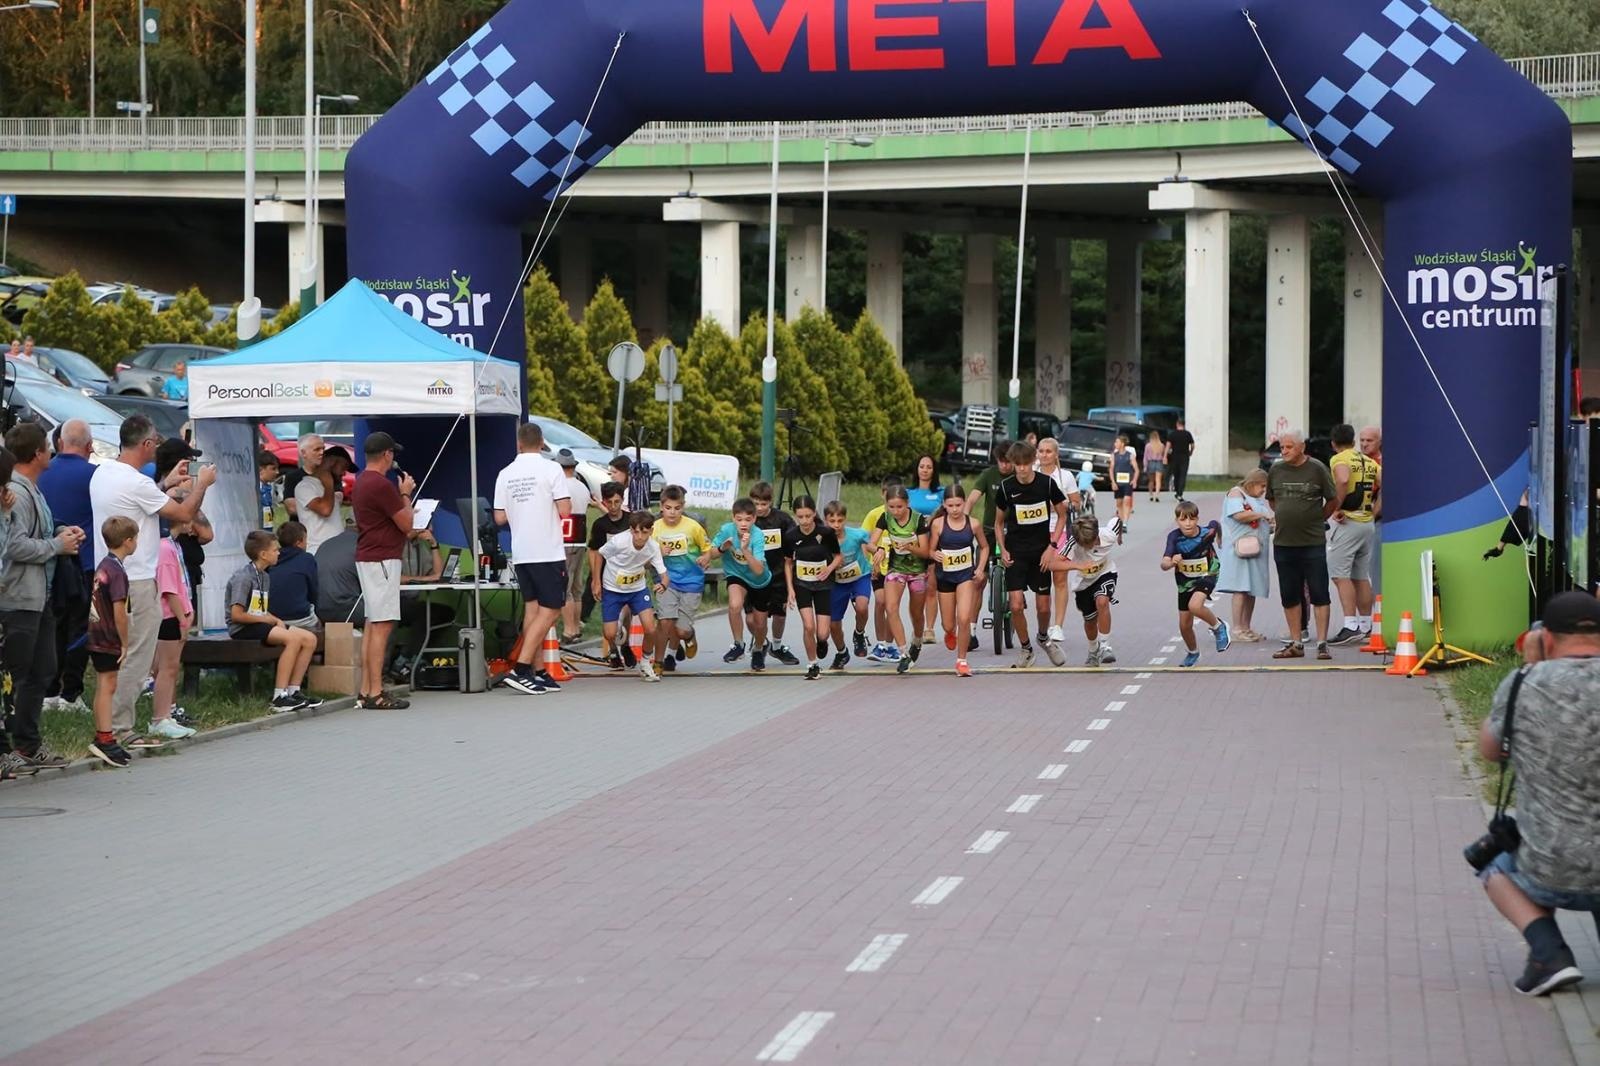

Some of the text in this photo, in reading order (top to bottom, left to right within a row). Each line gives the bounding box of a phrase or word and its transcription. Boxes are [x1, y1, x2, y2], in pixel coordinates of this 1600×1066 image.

[702, 0, 1163, 73] META
[1414, 248, 1516, 265] Wodzisław Śląski
[415, 276, 450, 291] Śląski
[1407, 265, 1553, 304] mosir
[378, 292, 491, 328] osir
[1422, 304, 1536, 329] centrum
[427, 387, 453, 395] MITKO
[689, 476, 732, 491] mosir
[693, 489, 725, 498] centrum
[1022, 508, 1043, 519] 120
[947, 554, 967, 565] 140
[837, 569, 857, 580] 122
[1182, 563, 1202, 573] 115
